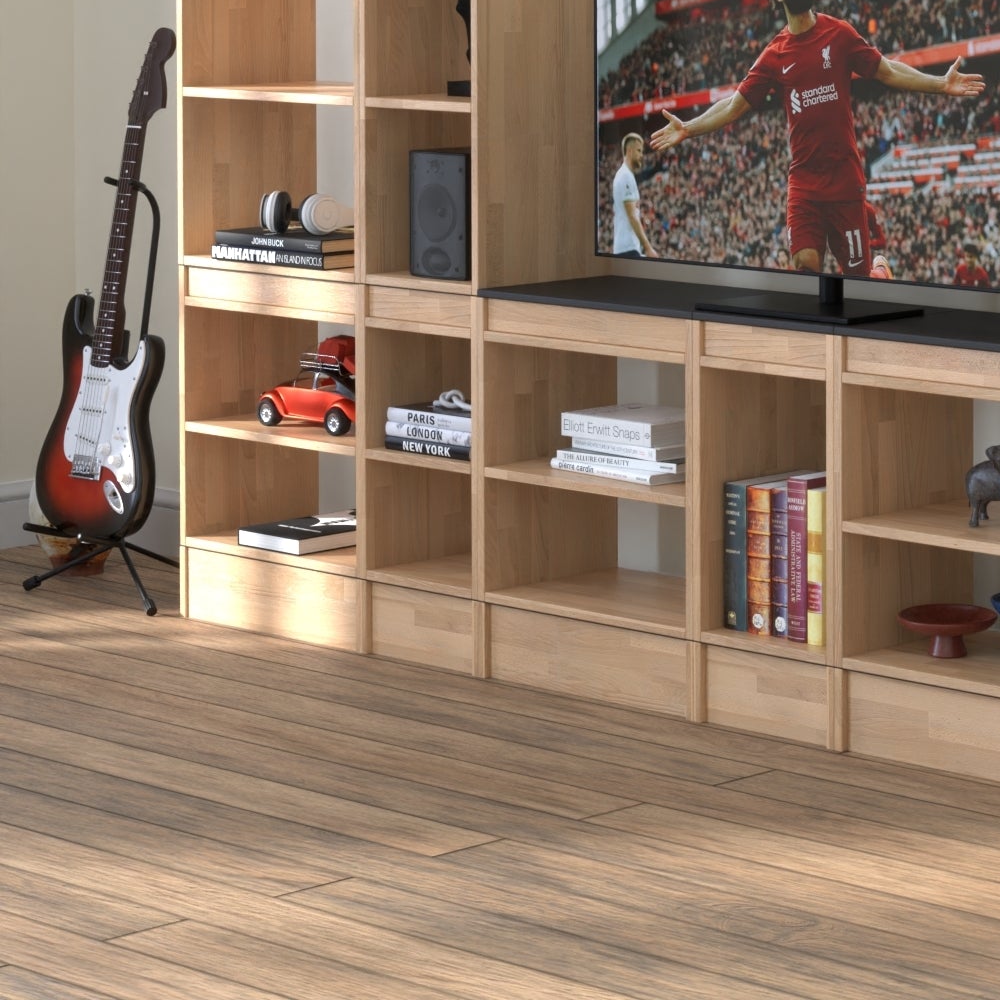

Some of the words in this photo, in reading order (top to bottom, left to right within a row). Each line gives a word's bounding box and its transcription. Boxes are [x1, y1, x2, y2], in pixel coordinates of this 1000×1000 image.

[801, 83, 835, 99] standard
[802, 91, 839, 108] chartered
[251, 236, 267, 246] JOHN
[267, 238, 284, 247] BUCK
[845, 229, 863, 258] 11
[211, 245, 276, 264] MANHATTAN
[407, 412, 435, 426] PARIS
[406, 426, 443, 441] LONDON
[563, 418, 585, 433] Elliott
[587, 421, 610, 437] Erwitt
[612, 425, 641, 442] Snaps
[402, 440, 423, 453] NEW
[425, 443, 451, 457] YORK
[558, 460, 575, 471] pierre
[576, 463, 594, 474] cardin
[563, 453, 574, 461] THE
[575, 453, 597, 463] ALLURE
[606, 457, 630, 467] BEAUTY
